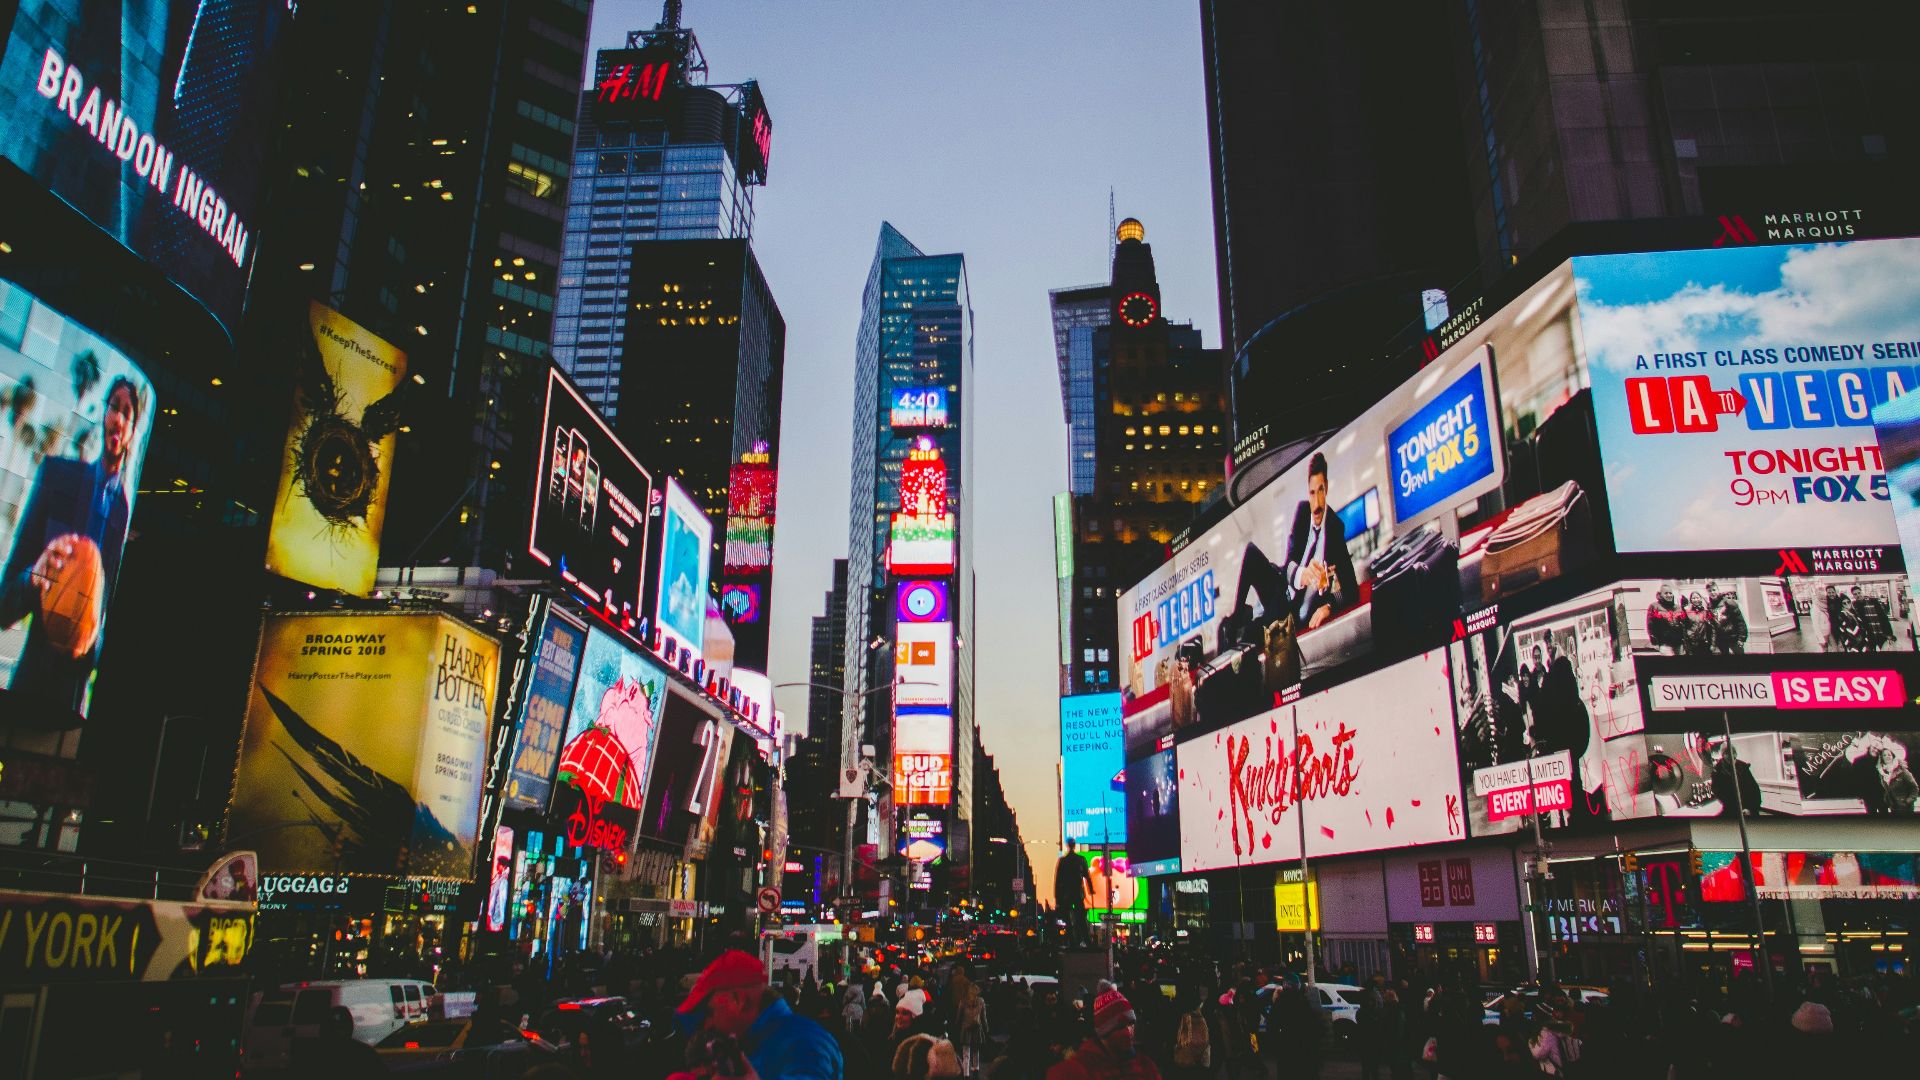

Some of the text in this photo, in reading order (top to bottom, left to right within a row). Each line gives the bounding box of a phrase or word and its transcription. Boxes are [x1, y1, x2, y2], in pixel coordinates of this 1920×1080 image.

[598, 61, 670, 103] H&M
[37, 47, 249, 268] BRANDON INGRAM
[1765, 209, 1863, 225] MARRIOTT
[1768, 224, 1855, 240] MARQUIS
[1440, 297, 1484, 337] MARRIOTT
[1441, 315, 1481, 350] MARQUIS
[1635, 341, 1920, 370] A FIRST CLASS COMEDY SERI
[899, 392, 940, 408] 4:40
[1637, 380, 1709, 428] LA
[1719, 392, 1736, 412] TO
[1234, 425, 1269, 454] MARRIOTT
[1397, 394, 1475, 469] TONIGHT
[1426, 442, 1464, 482] FOX
[1463, 424, 1480, 458] 5
[1724, 446, 1884, 475] TONIGHT
[1792, 475, 1866, 503] FOX
[1869, 474, 1891, 502] 5
[1812, 549, 1884, 560] MARRIOTT
[1814, 559, 1879, 571] MARQUIS
[1151, 583, 1168, 602] CLASS
[1188, 552, 1209, 575] SERIES
[1159, 574, 1214, 645] VEGAS
[1465, 603, 1499, 624] MARRIOTT
[1467, 615, 1497, 634] MARQUIS
[305, 634, 386, 644] BROADWAY
[301, 645, 386, 656] SPRING 2018
[443, 634, 490, 682] HARRY
[287, 671, 392, 682] HarryPotterThePlay.com
[434, 664, 487, 717] POTTER
[1662, 676, 1888, 703] SWITCHING IS EASY
[1065, 710, 1084, 719] THE
[1087, 708, 1109, 717] NEW
[1065, 731, 1100, 742] YOU'LL
[1066, 743, 1112, 753] KEEPING.
[434, 764, 458, 780] SPRING
[437, 753, 473, 770] BROADWAY
[901, 756, 944, 772] BUD
[1289, 722, 1362, 806] Boots
[895, 771, 949, 787] LIGHT
[1479, 770, 1497, 790] YOU
[1497, 767, 1519, 786] HAVE
[1066, 808, 1084, 816] TEXT
[1449, 863, 1468, 881] UNI
[256, 876, 349, 894] UGGAGE
[1450, 884, 1471, 902] QLO
[1646, 862, 1685, 927] T
[25, 909, 123, 968] YORK
